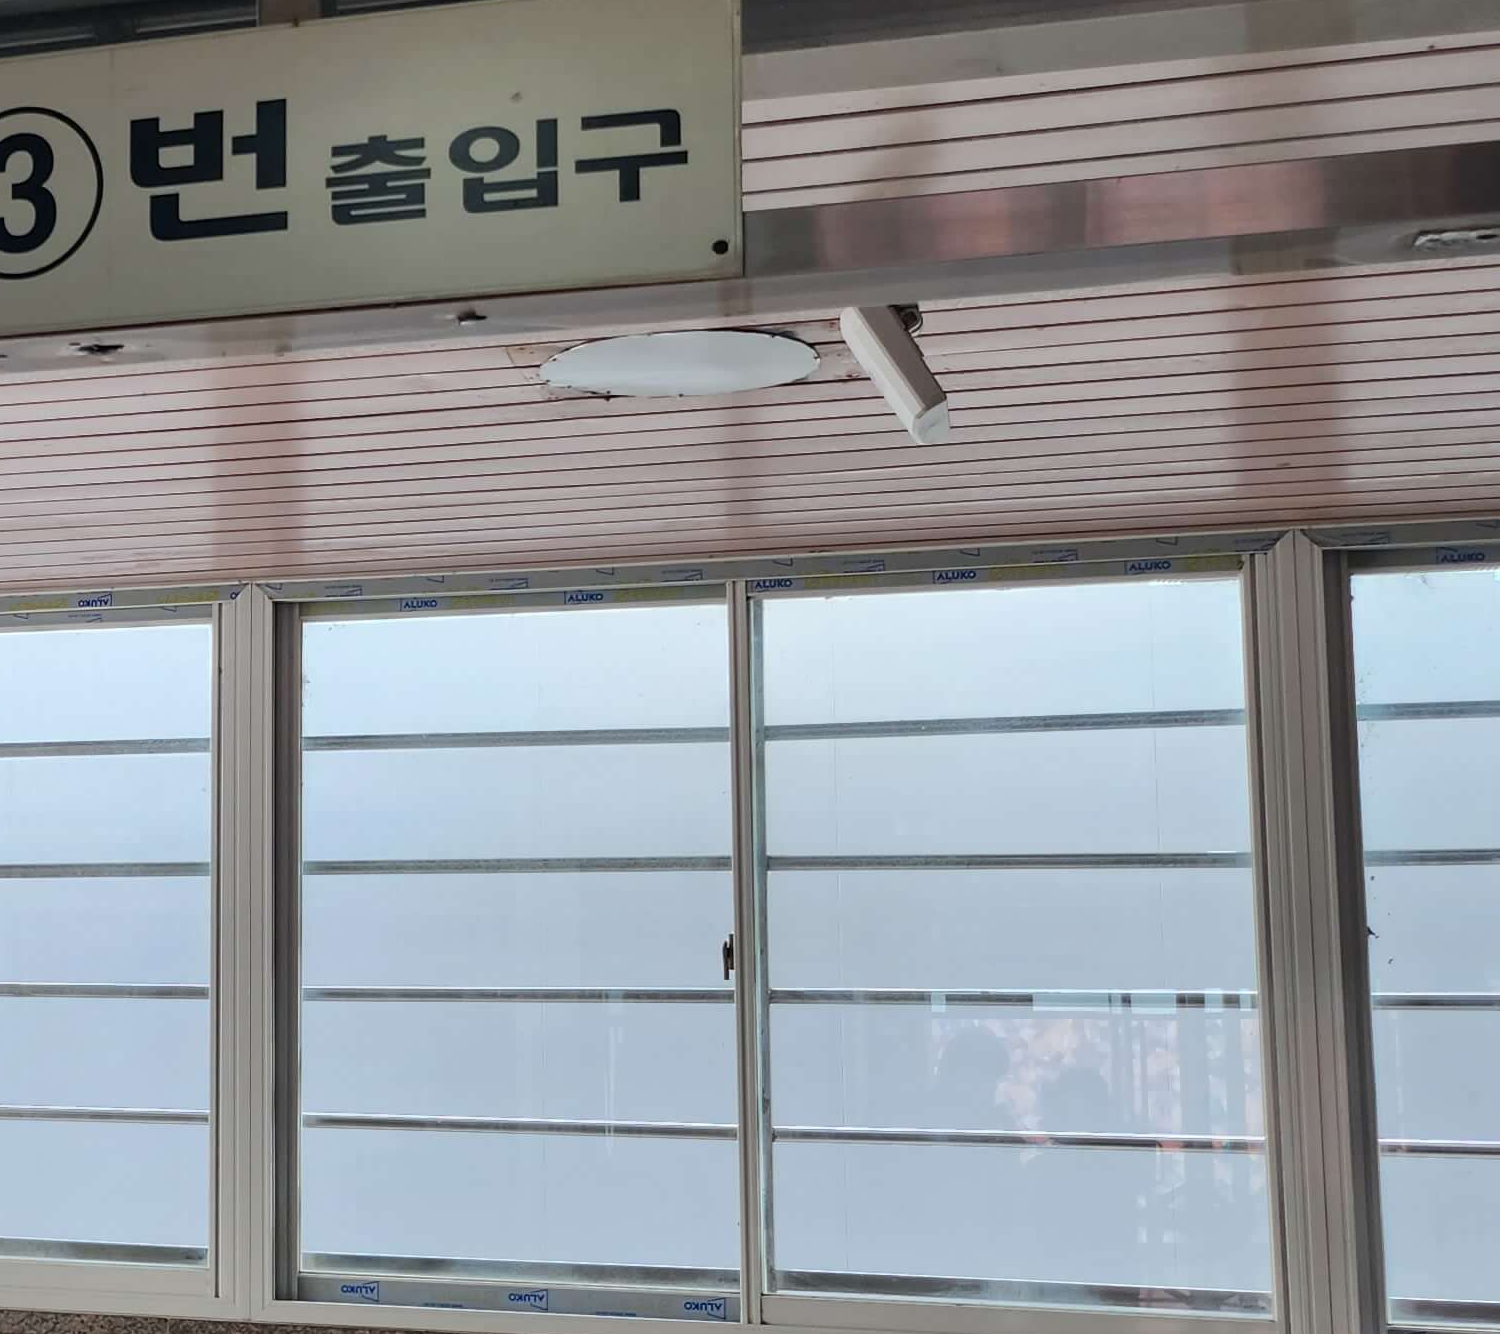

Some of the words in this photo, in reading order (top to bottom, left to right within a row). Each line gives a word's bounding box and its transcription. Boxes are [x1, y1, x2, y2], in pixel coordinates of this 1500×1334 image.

[324, 108, 688, 227] 출입구
[1441, 552, 1486, 563] ALUKO
[1130, 560, 1171, 571] ALUKO
[937, 570, 976, 581] ALUKO
[755, 578, 792, 588] ALUKO
[78, 597, 110, 608] ALUKO
[568, 592, 604, 603] ALUKO
[404, 598, 439, 609] ALUKO
[340, 1284, 376, 1294] ALUKO
[508, 1292, 545, 1302] ALUKO
[684, 1301, 723, 1311] ALUKO
